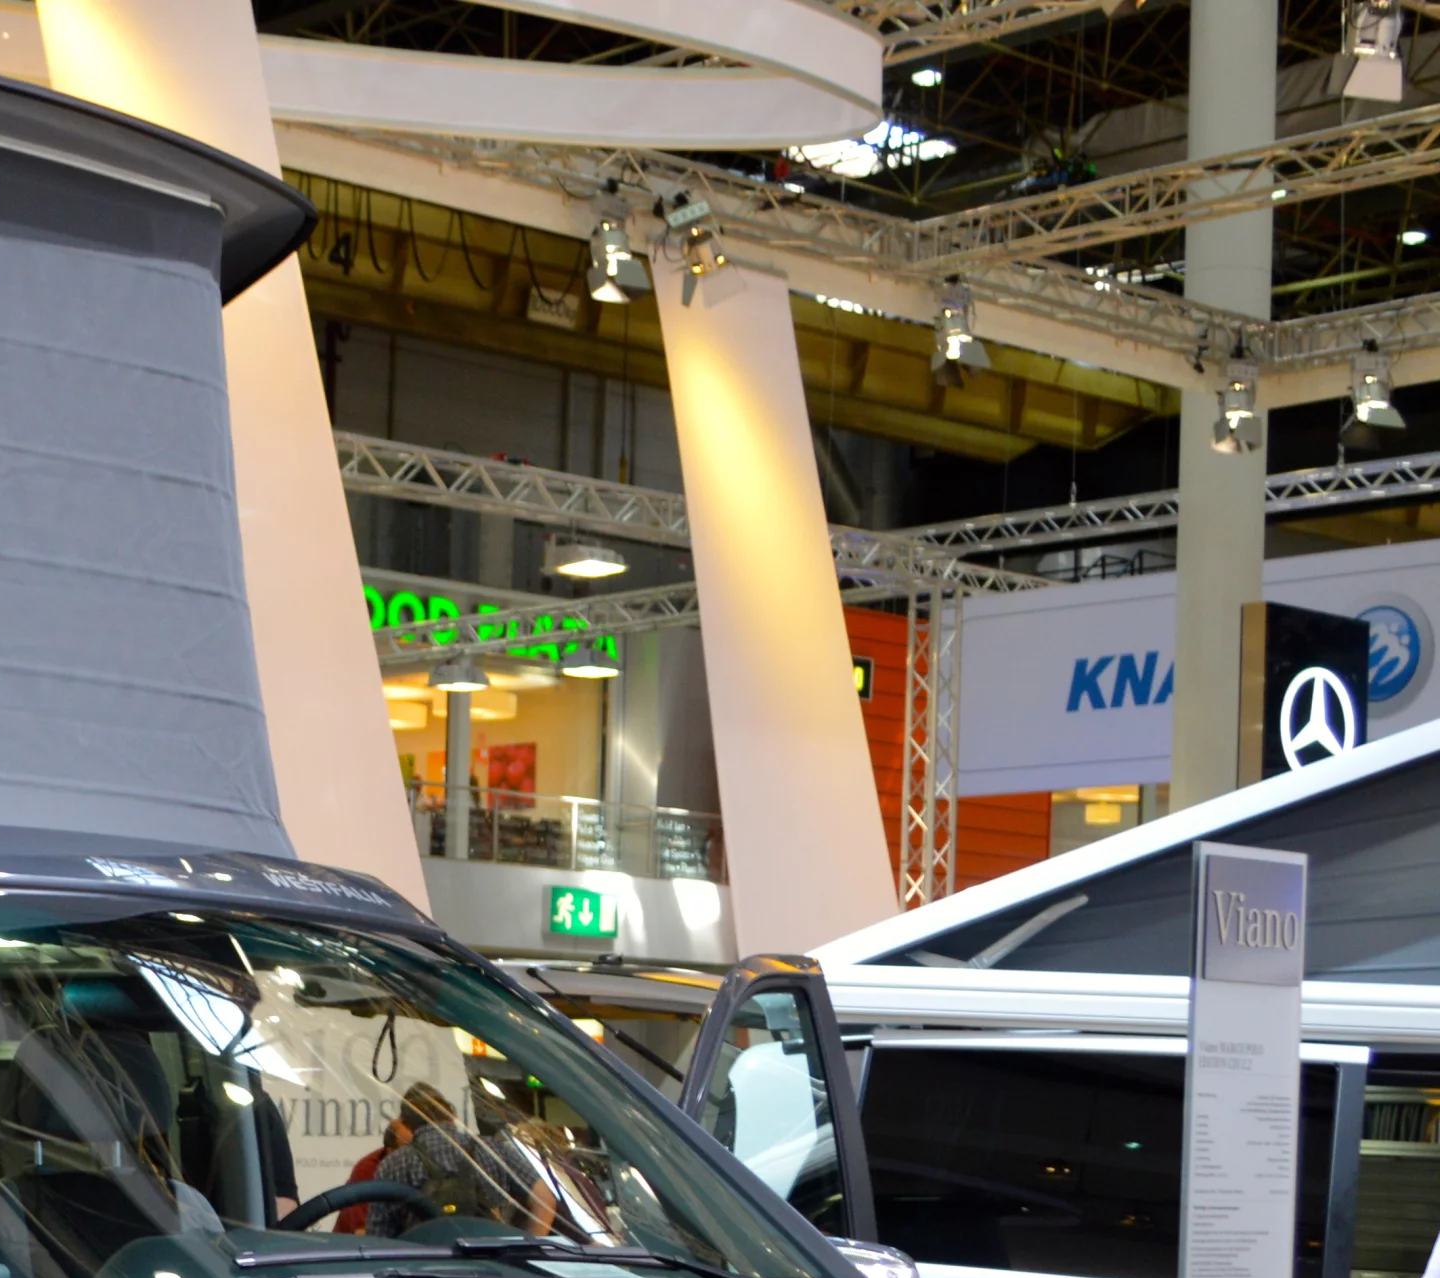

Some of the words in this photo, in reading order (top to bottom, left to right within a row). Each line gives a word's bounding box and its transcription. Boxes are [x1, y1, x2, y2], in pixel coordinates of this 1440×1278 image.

[328, 231, 352, 276] 4
[262, 870, 392, 908] WESTFALIA
[1212, 889, 1300, 951] Viano
